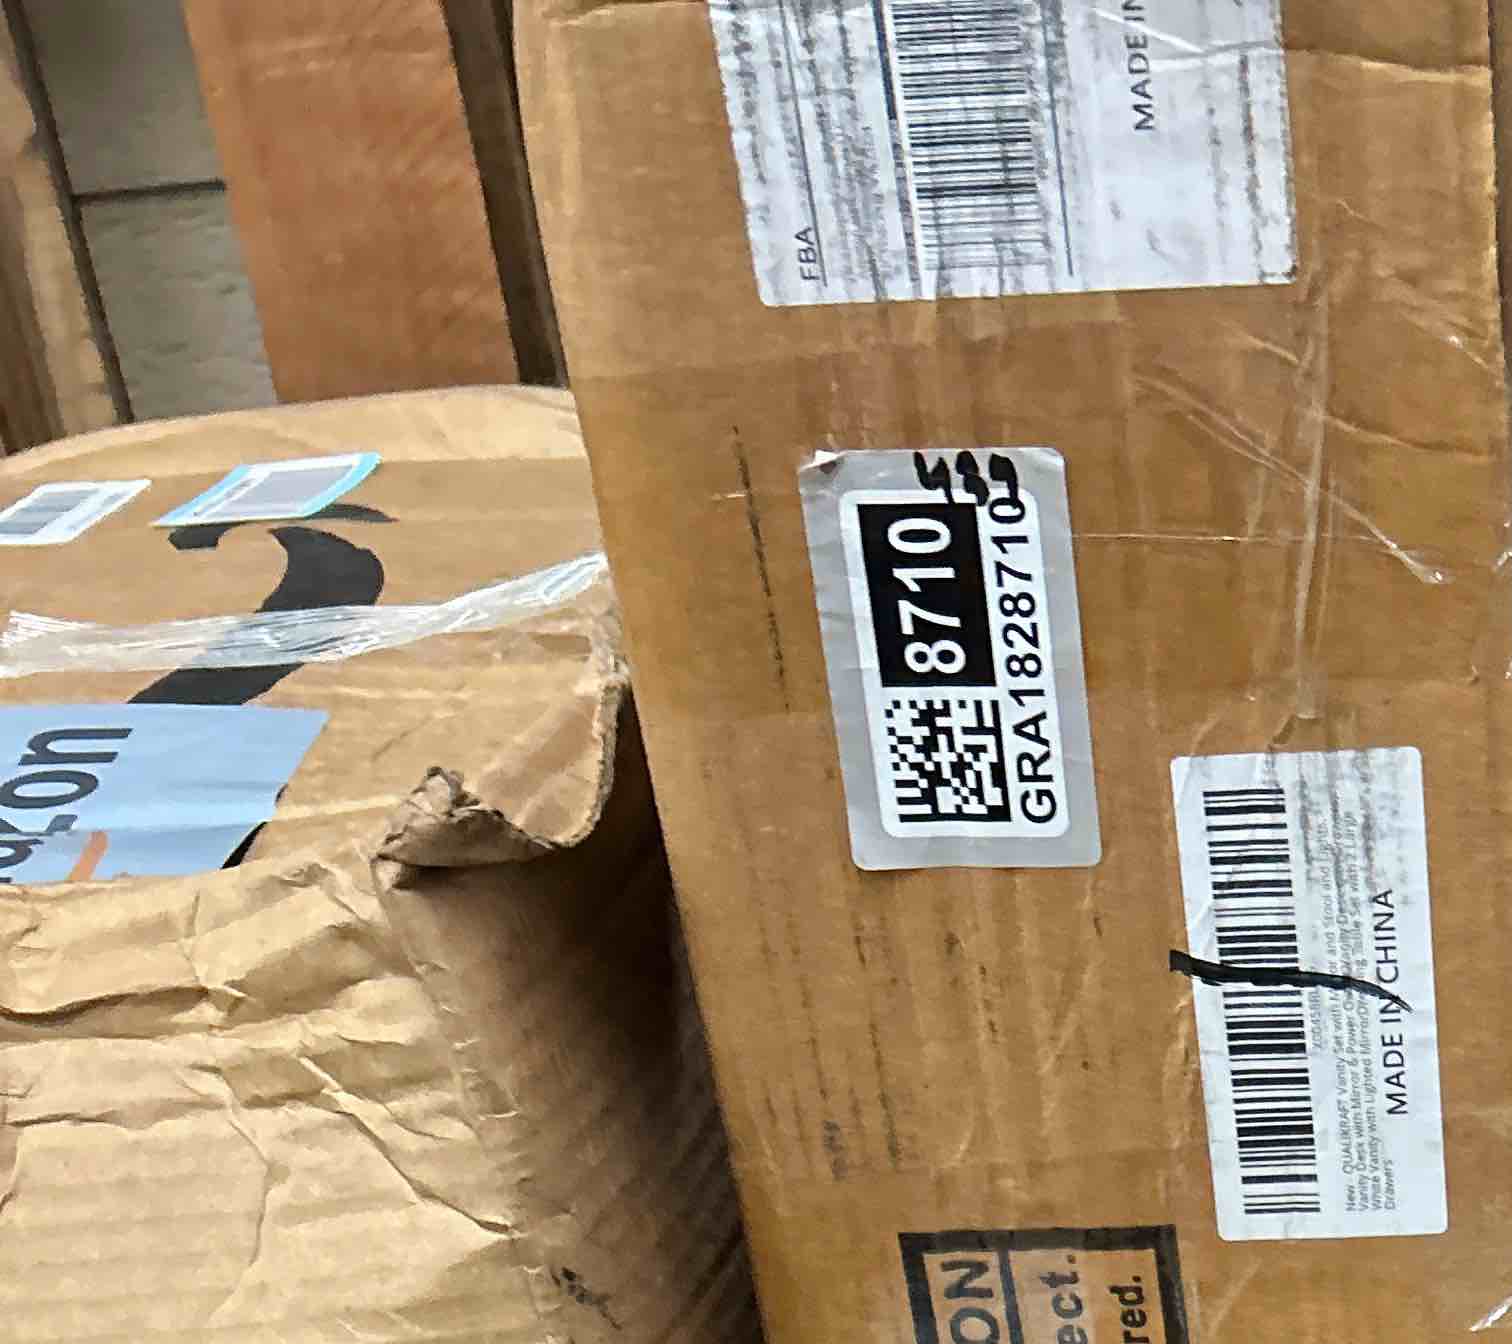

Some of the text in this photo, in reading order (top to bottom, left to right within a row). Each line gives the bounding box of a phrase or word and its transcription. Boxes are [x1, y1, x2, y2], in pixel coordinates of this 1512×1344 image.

[1124, 35, 1154, 130] MADE
[794, 227, 819, 281] FBA
[887, 516, 967, 675] 8710
[988, 497, 1058, 824] GRA1828710
[1371, 888, 1409, 1115] MADE IN CHINA
